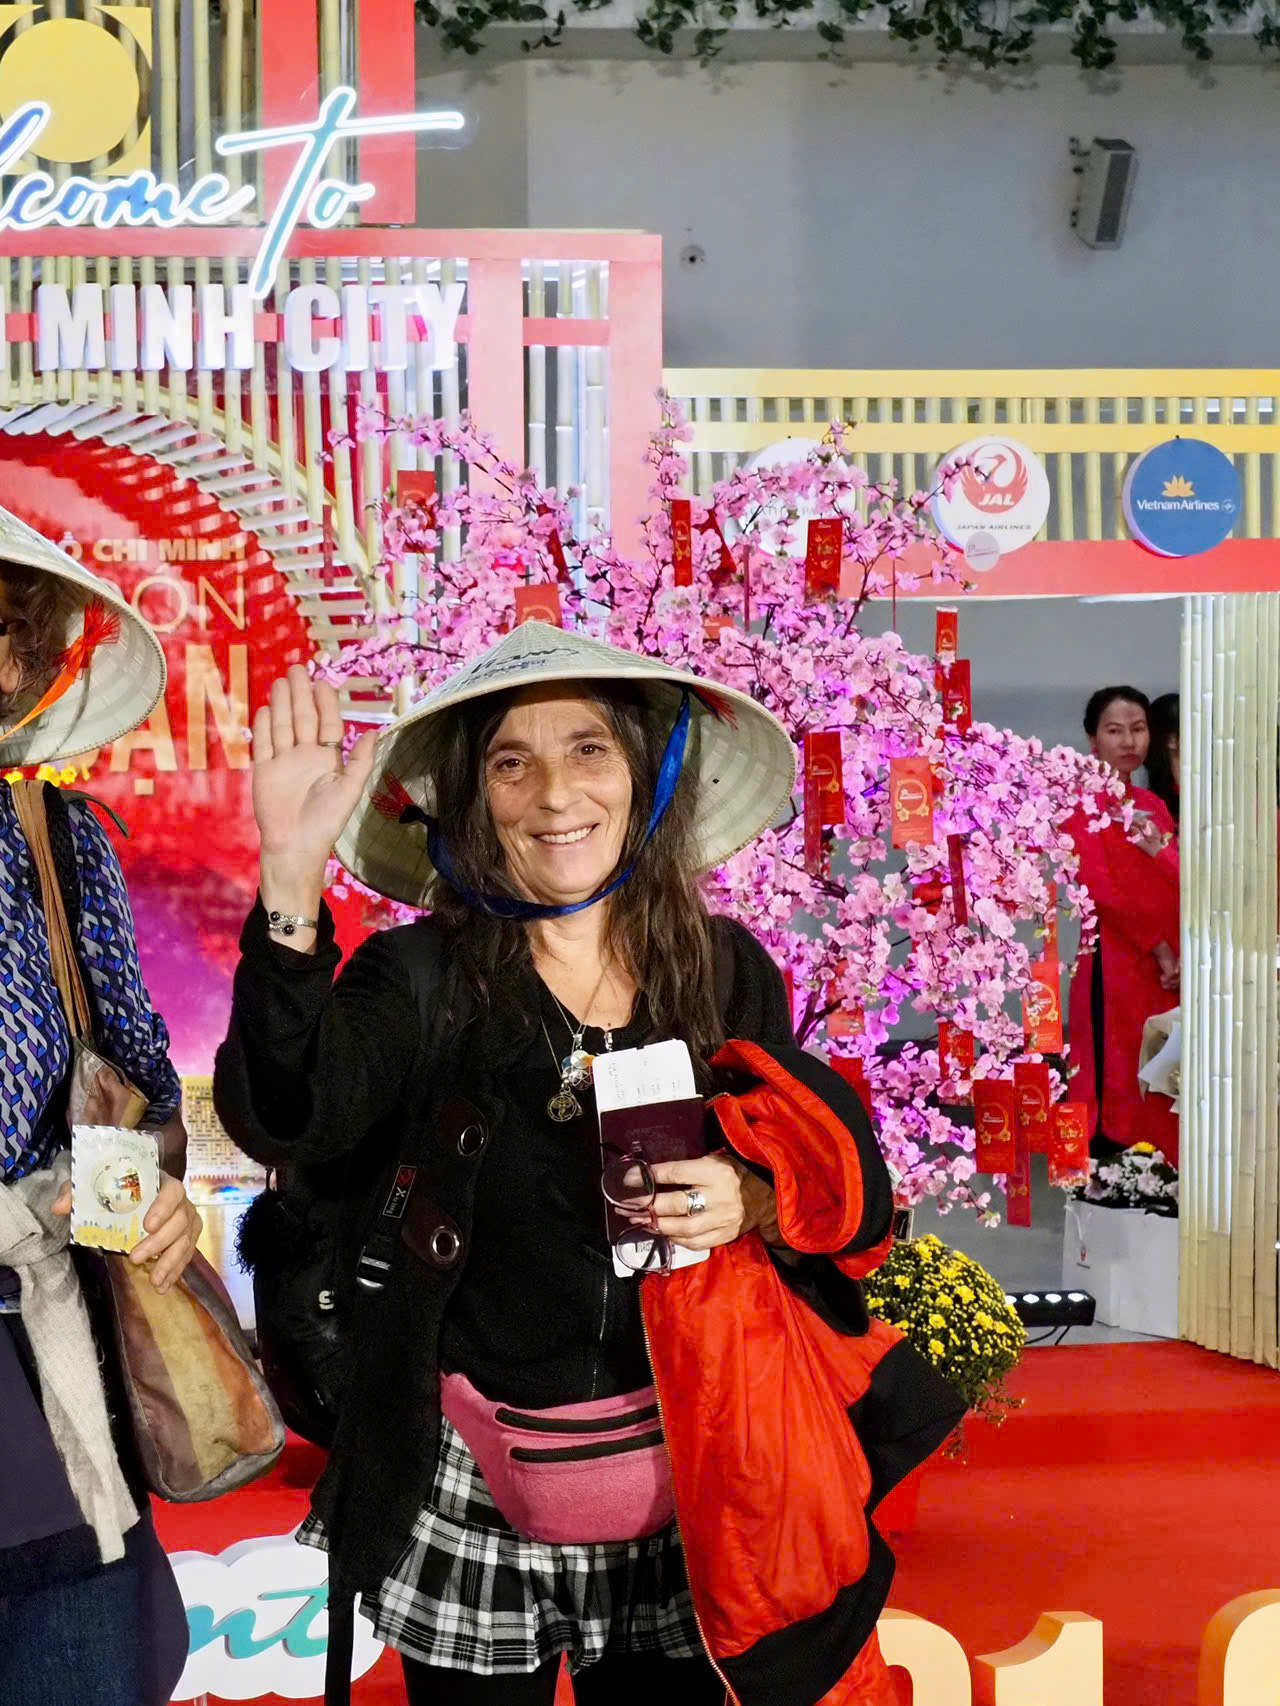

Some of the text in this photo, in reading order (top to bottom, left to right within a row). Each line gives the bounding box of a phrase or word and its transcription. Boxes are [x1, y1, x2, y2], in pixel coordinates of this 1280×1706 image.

[36, 283, 256, 372] MINH
[284, 283, 467, 372] CITY
[979, 493, 1015, 505] JAL
[1136, 499, 1220, 511] Vietnam Airlines
[159, 538, 246, 561] MINH
[92, 643, 251, 796] ẠN
